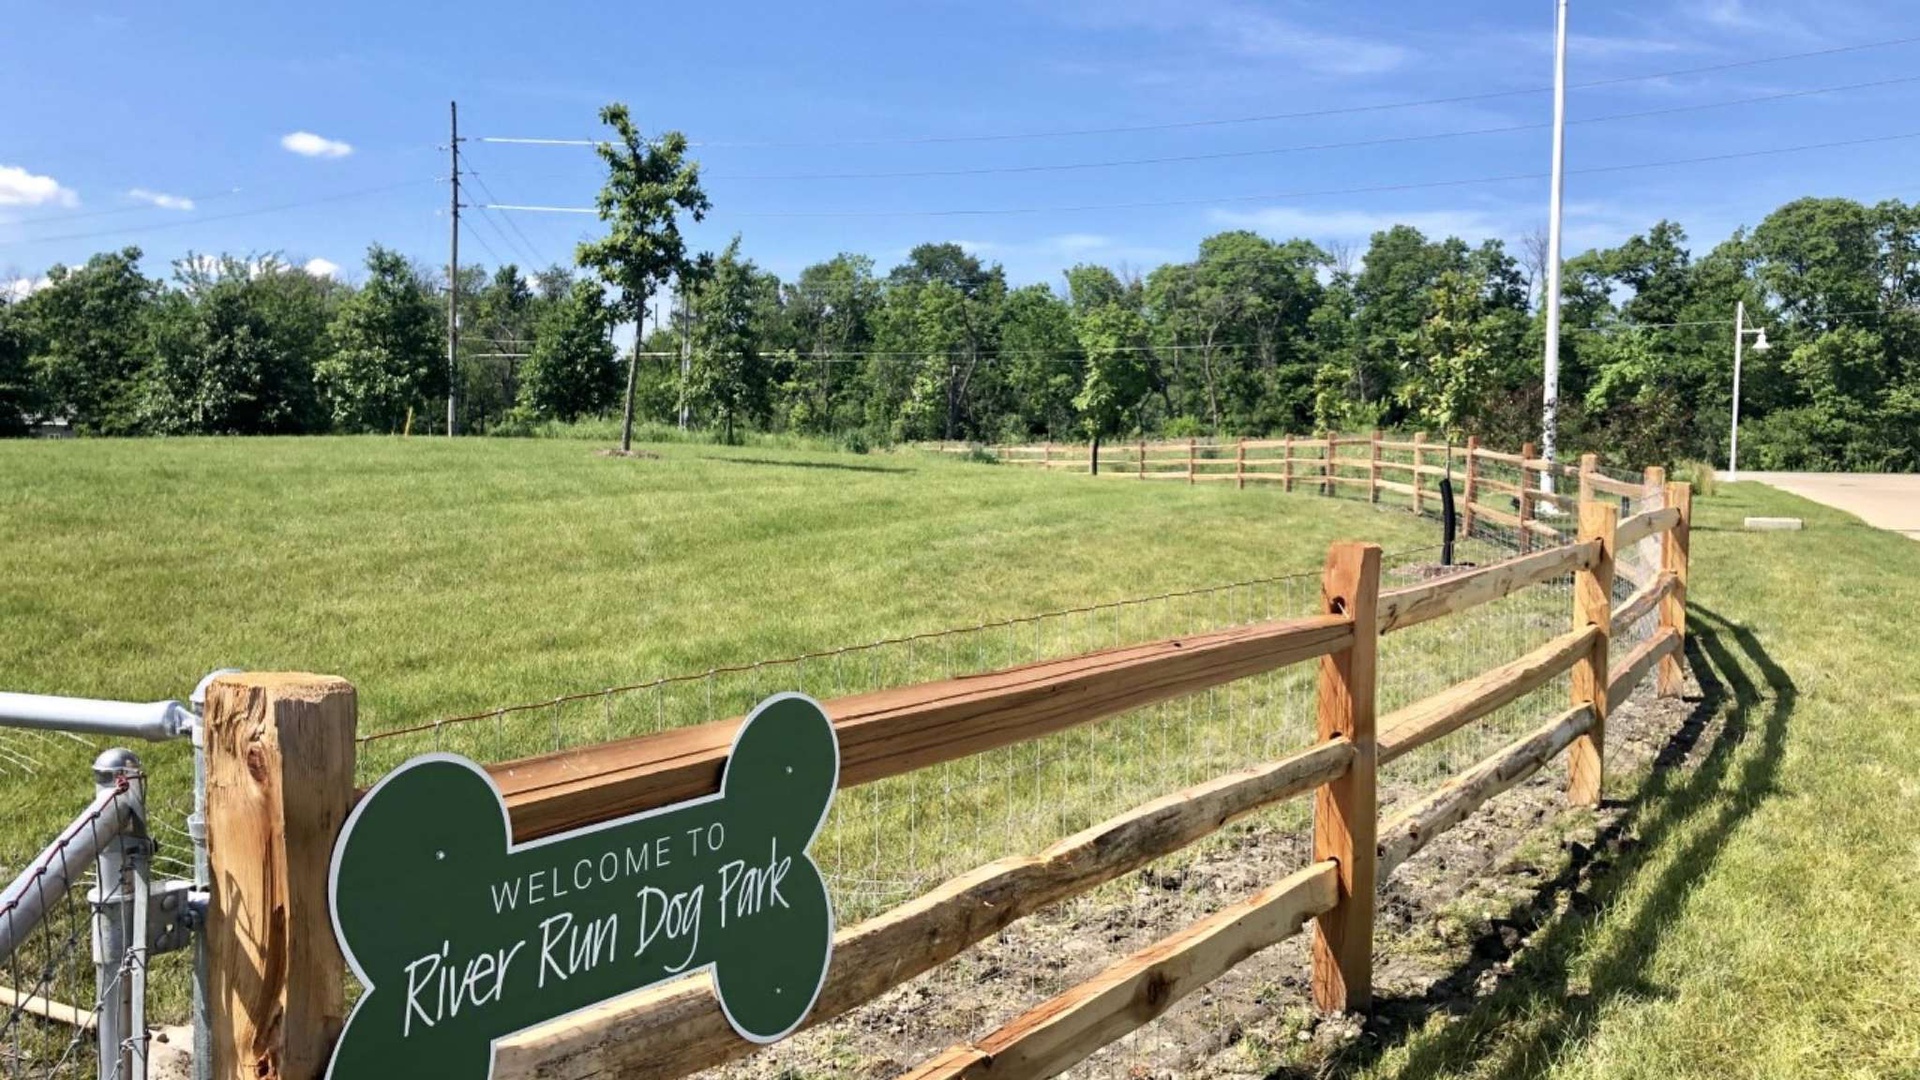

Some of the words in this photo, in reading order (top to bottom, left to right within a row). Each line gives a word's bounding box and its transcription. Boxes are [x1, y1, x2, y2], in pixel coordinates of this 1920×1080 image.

[403, 939, 526, 1037] River
[538, 912, 618, 988] Run
[634, 884, 705, 973] Dog
[717, 837, 792, 928] Park
[491, 836, 671, 914] WELCOME
[686, 822, 725, 857] TO
